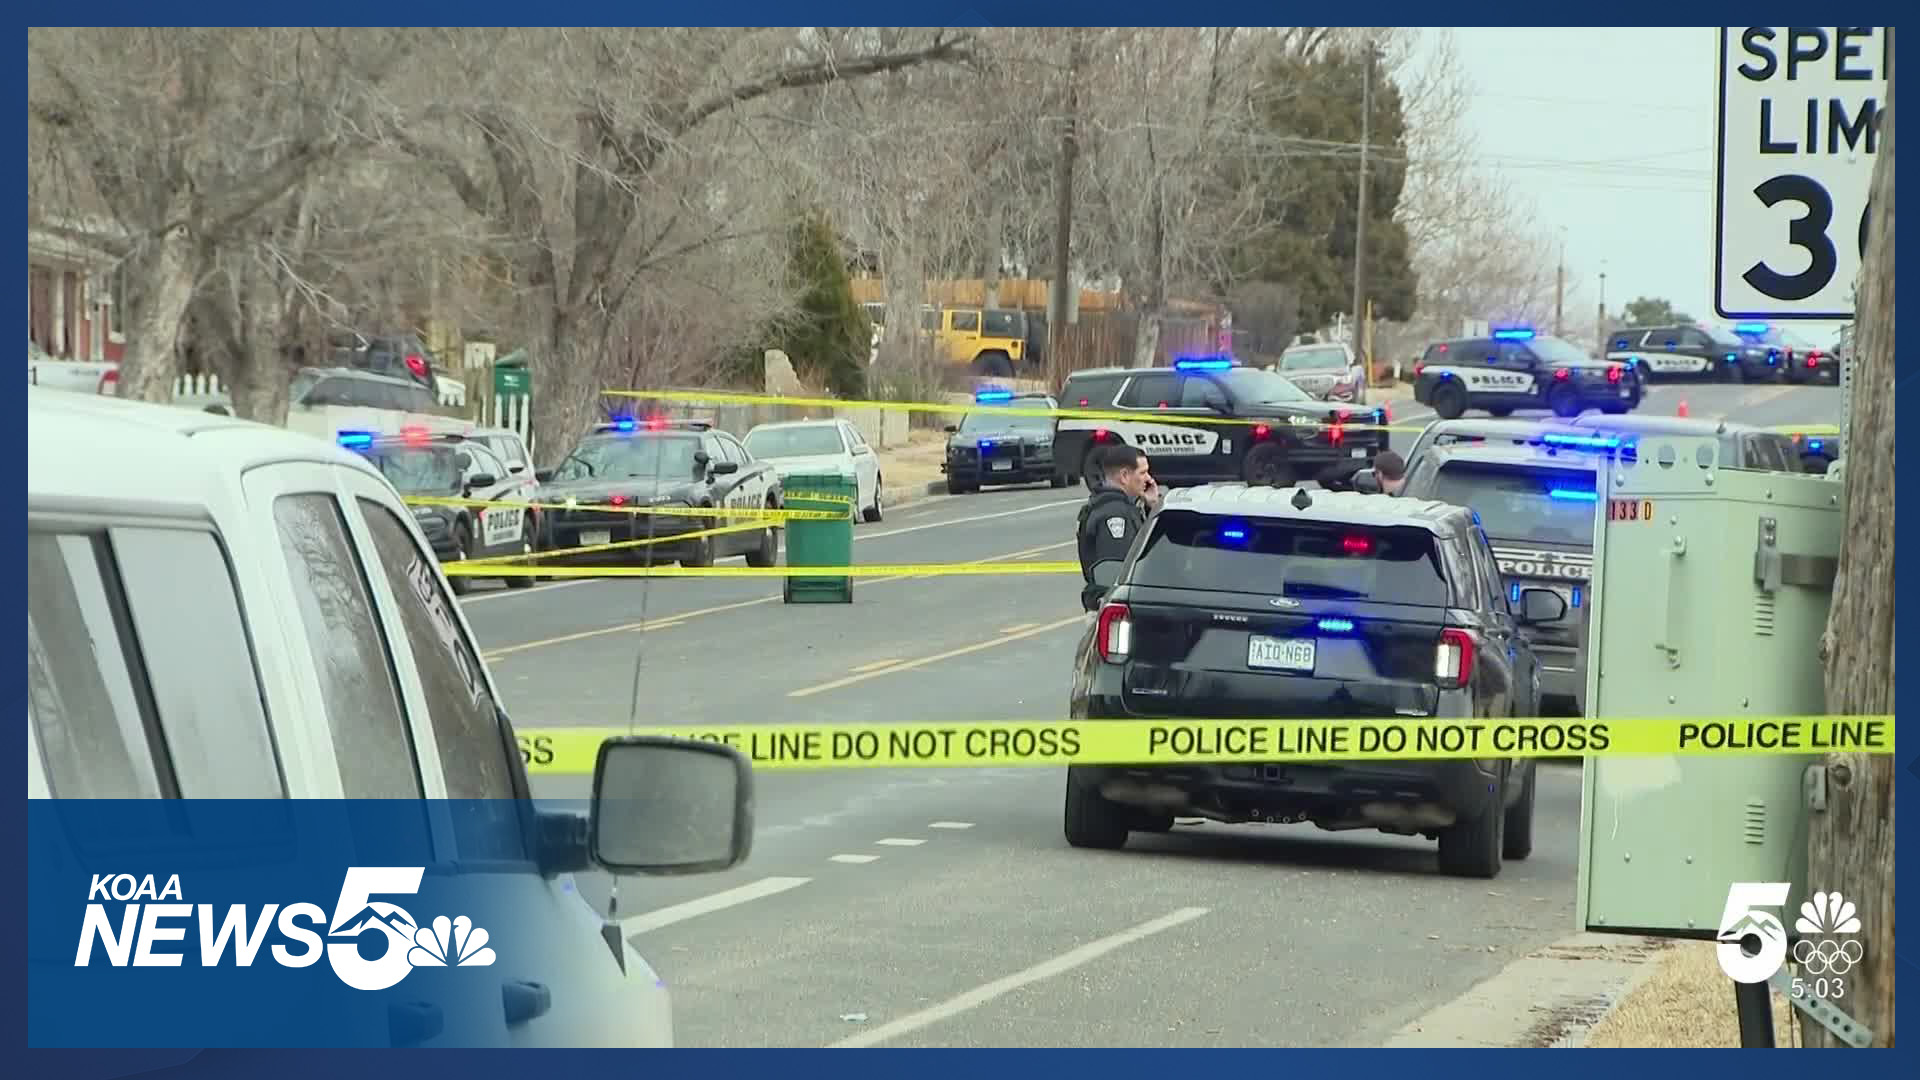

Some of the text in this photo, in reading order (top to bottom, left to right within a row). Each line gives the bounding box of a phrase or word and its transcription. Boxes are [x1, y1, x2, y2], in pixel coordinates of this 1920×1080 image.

[1737, 27, 1888, 81] SPE
[1759, 98, 1877, 154] LIM
[1742, 174, 1872, 301] 3
[1135, 433, 1207, 445] POLICE
[487, 508, 520, 531] POLICE
[752, 732, 822, 760] LINE
[832, 731, 879, 760] DO
[889, 729, 957, 759] NOT
[965, 728, 1081, 757] CROSS
[1149, 727, 1268, 755] POLICE
[1278, 727, 1349, 753] LINE
[1359, 726, 1407, 752] DO
[1416, 725, 1485, 752] NOT
[1492, 724, 1609, 752] CROSS
[1679, 722, 1801, 749] POLICE
[1811, 721, 1884, 747] LINE
